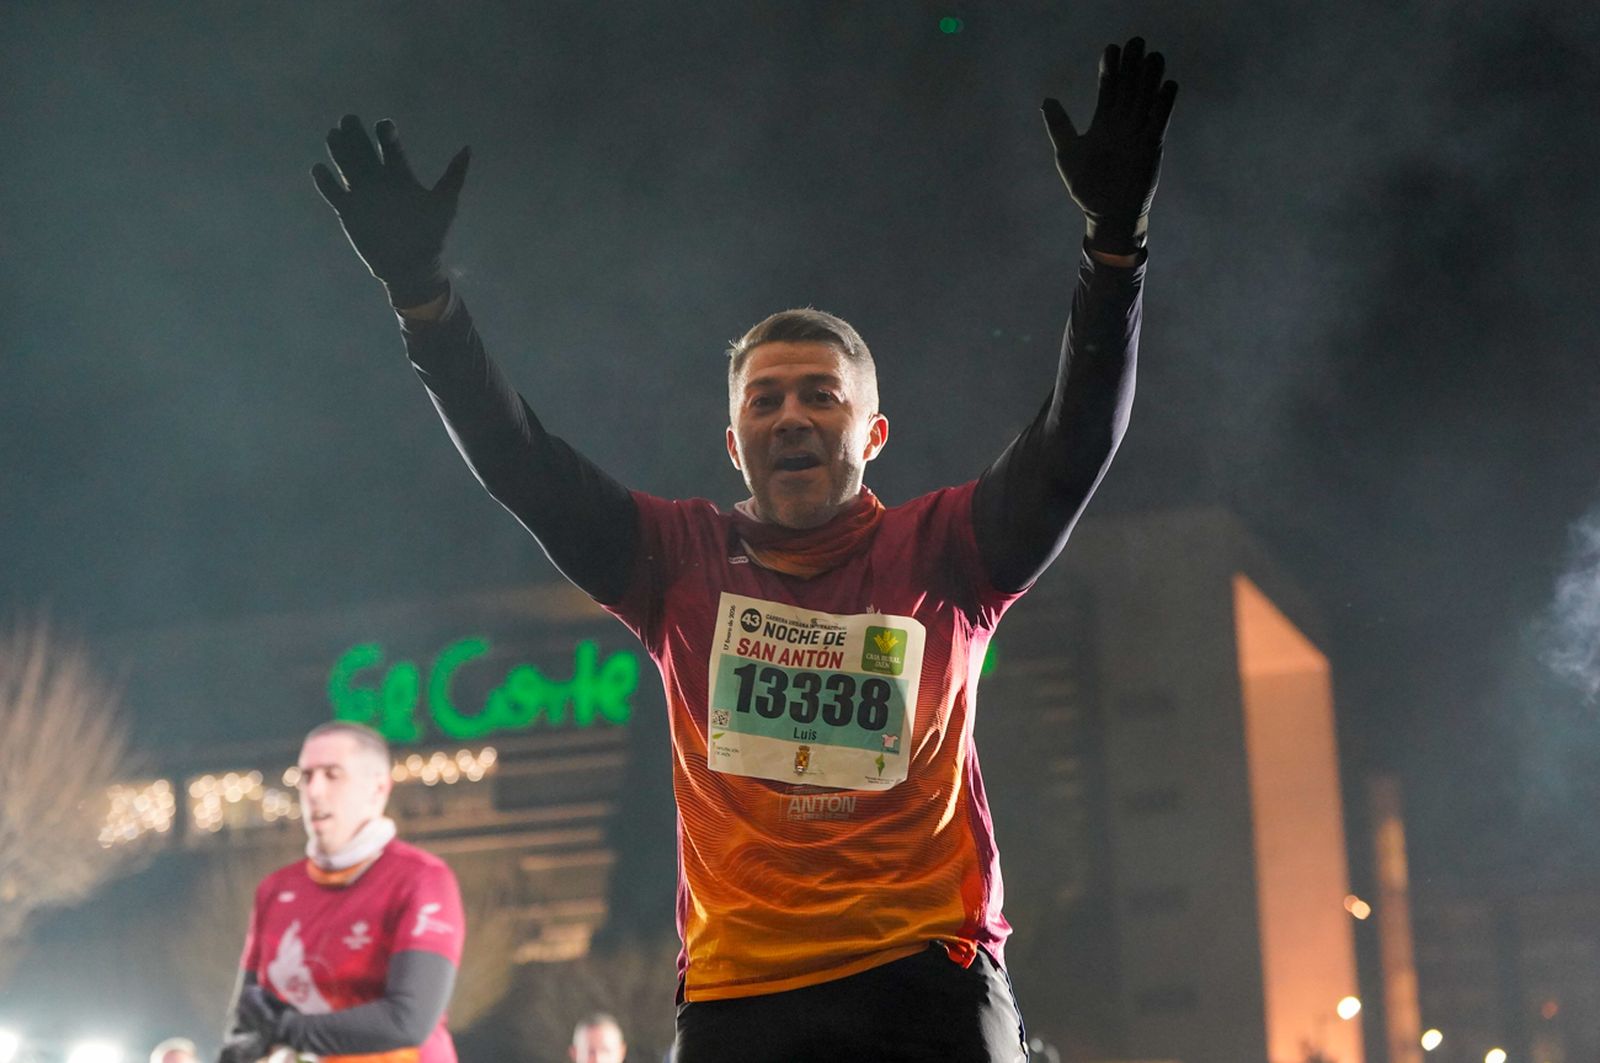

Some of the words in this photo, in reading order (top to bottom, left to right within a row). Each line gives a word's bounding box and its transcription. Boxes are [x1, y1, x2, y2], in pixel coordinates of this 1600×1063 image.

[741, 613, 760, 627] 43
[765, 614, 788, 625] CARRERA
[763, 622, 821, 645] NOCHE
[823, 631, 847, 646] DE
[736, 638, 776, 662] SAN
[778, 646, 844, 669] ANTÓN
[865, 653, 880, 662] CAJA
[327, 642, 421, 743] El
[429, 636, 639, 740] Corte
[734, 663, 891, 731] 13338
[793, 727, 817, 741] Luis
[787, 793, 857, 814] ANTÓN
